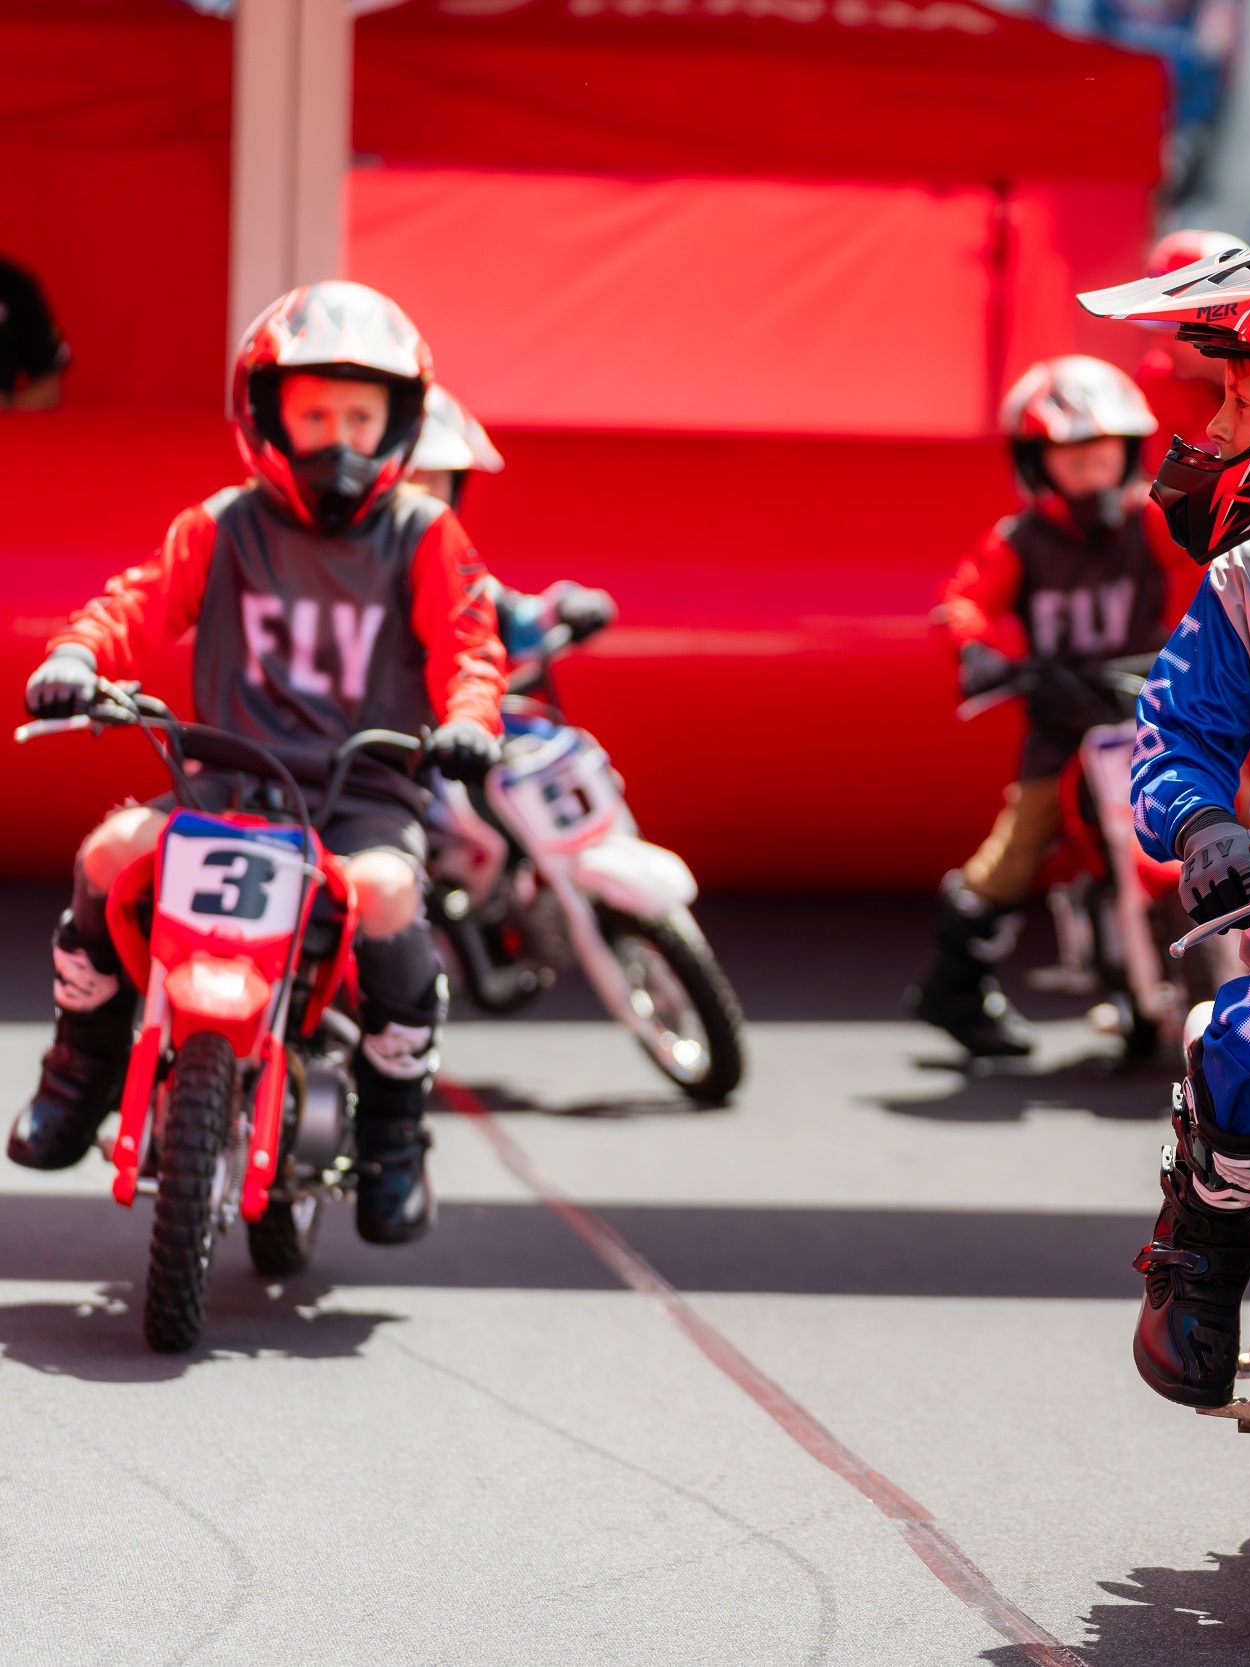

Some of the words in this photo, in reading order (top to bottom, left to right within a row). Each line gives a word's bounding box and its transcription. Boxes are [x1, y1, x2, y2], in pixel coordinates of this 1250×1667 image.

[1196, 302, 1238, 322] MZR
[242, 592, 384, 699] FLY
[1031, 577, 1135, 655] FLY
[191, 851, 275, 920] 3
[1184, 838, 1234, 883] FLY
